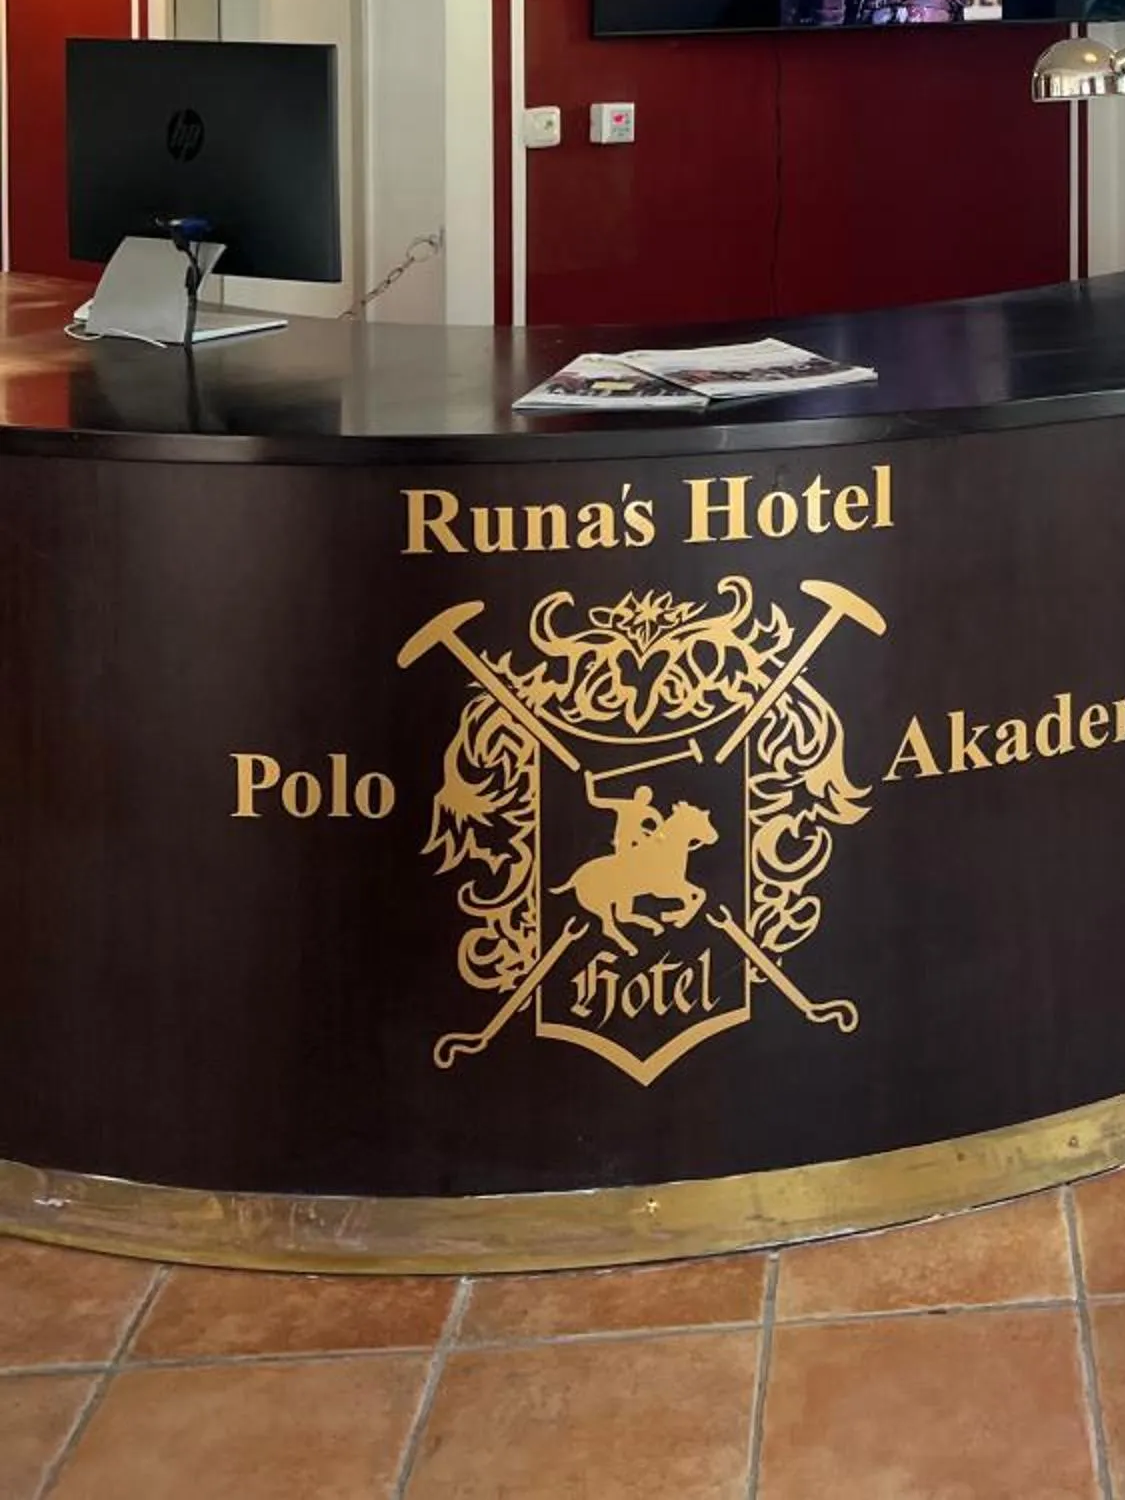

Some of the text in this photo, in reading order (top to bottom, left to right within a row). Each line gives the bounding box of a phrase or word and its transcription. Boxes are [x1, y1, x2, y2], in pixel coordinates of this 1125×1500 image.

[167, 109, 204, 161] hp
[401, 465, 895, 555] Runa's Hotel
[229, 753, 395, 819] Polo
[570, 948, 721, 1029] Hotel
